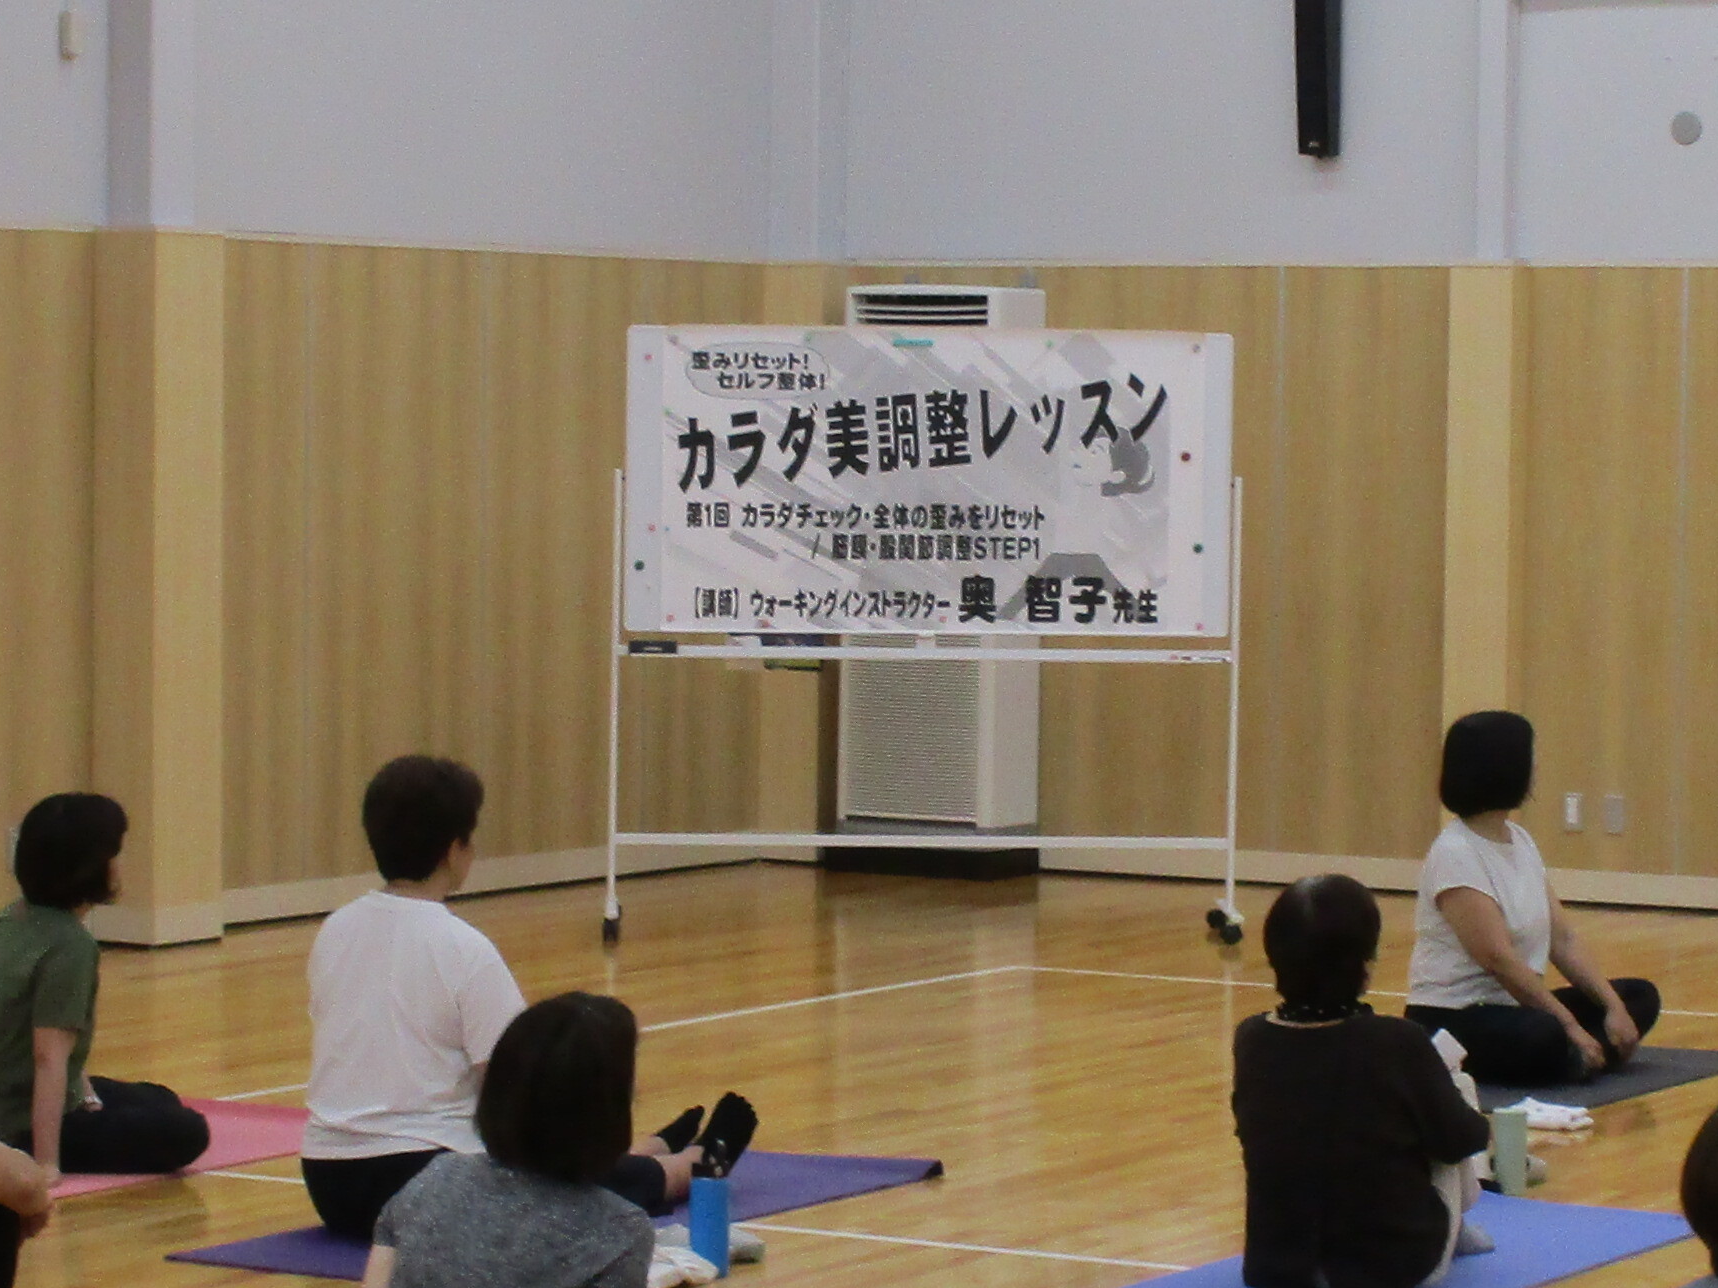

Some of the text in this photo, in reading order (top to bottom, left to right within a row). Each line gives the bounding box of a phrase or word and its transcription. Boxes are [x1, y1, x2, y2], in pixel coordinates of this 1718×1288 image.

[677, 373, 1168, 494] カラダ美調整レッスン
[686, 502, 730, 528] 第1回
[749, 588, 951, 620] ウォーキングインストラクター
